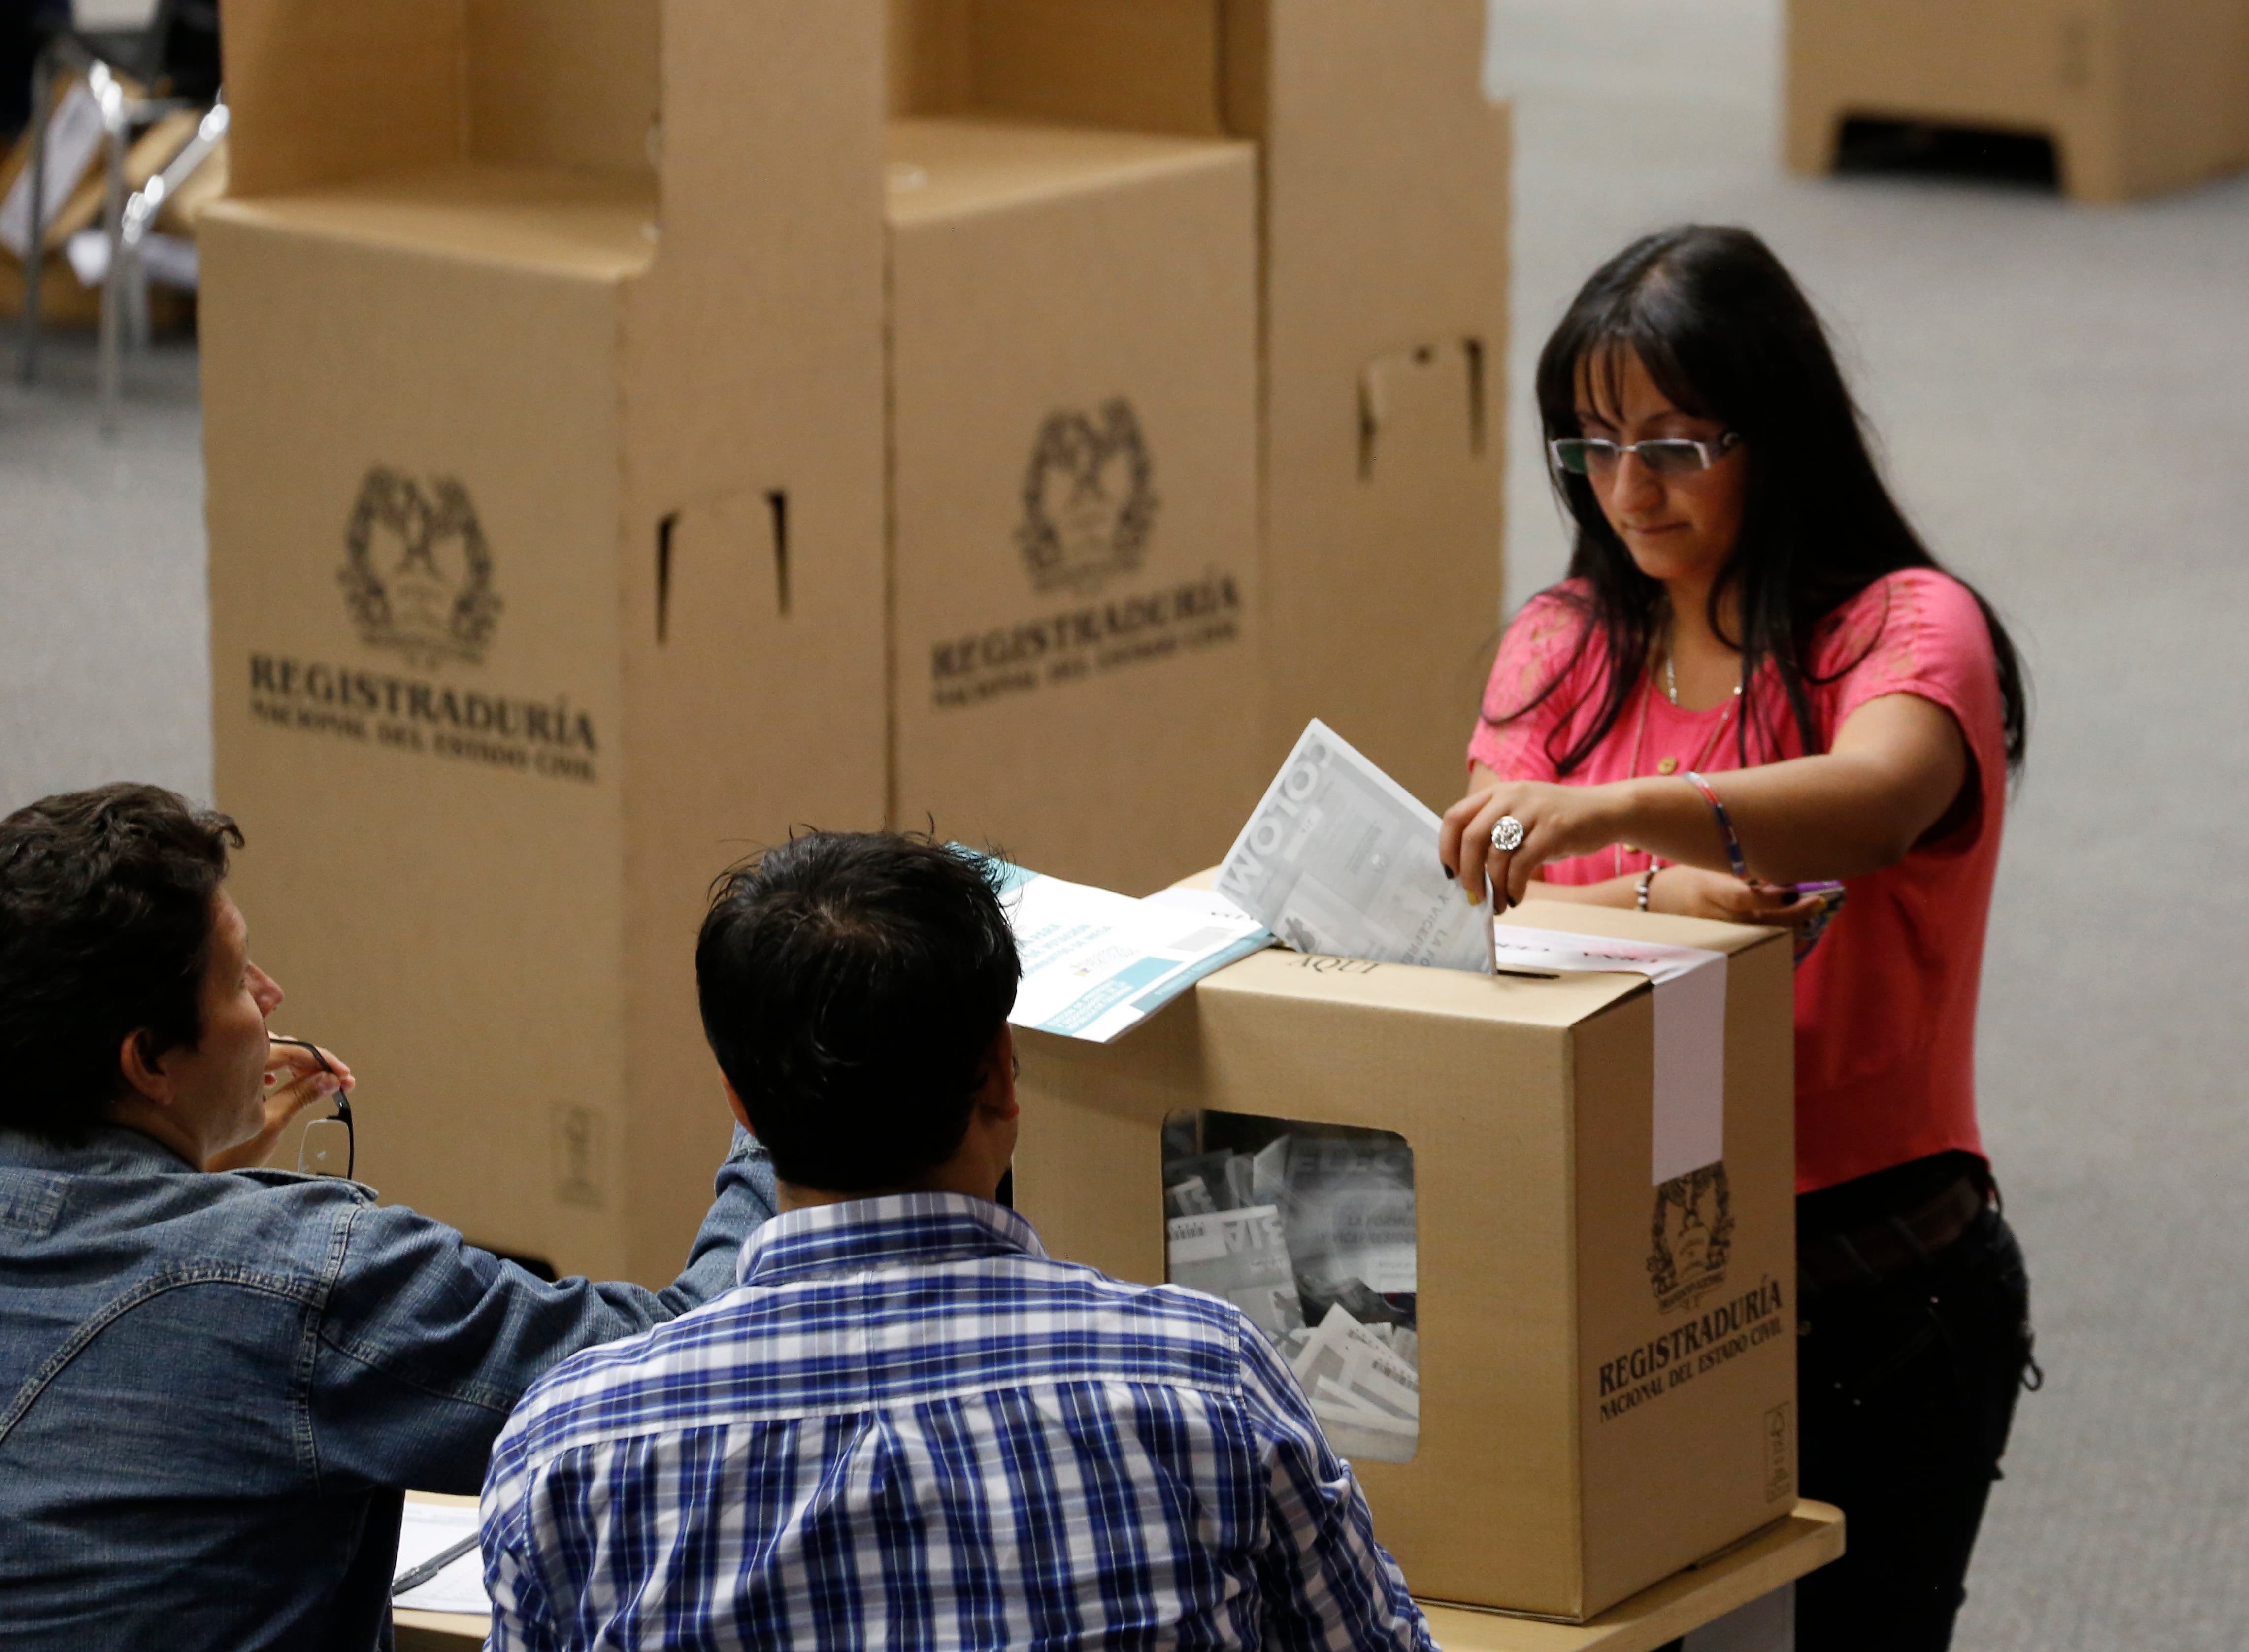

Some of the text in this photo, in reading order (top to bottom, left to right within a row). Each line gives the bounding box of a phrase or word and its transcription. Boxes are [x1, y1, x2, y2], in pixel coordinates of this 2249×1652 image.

[250, 651, 597, 754] REGISTRADURÍA
[1220, 736, 1334, 901] COLOM
[1599, 1273, 1783, 1397] REGISTRADURÍA
[1600, 1316, 1782, 1422] NACIONAL DEL ESTADO CIVIL
